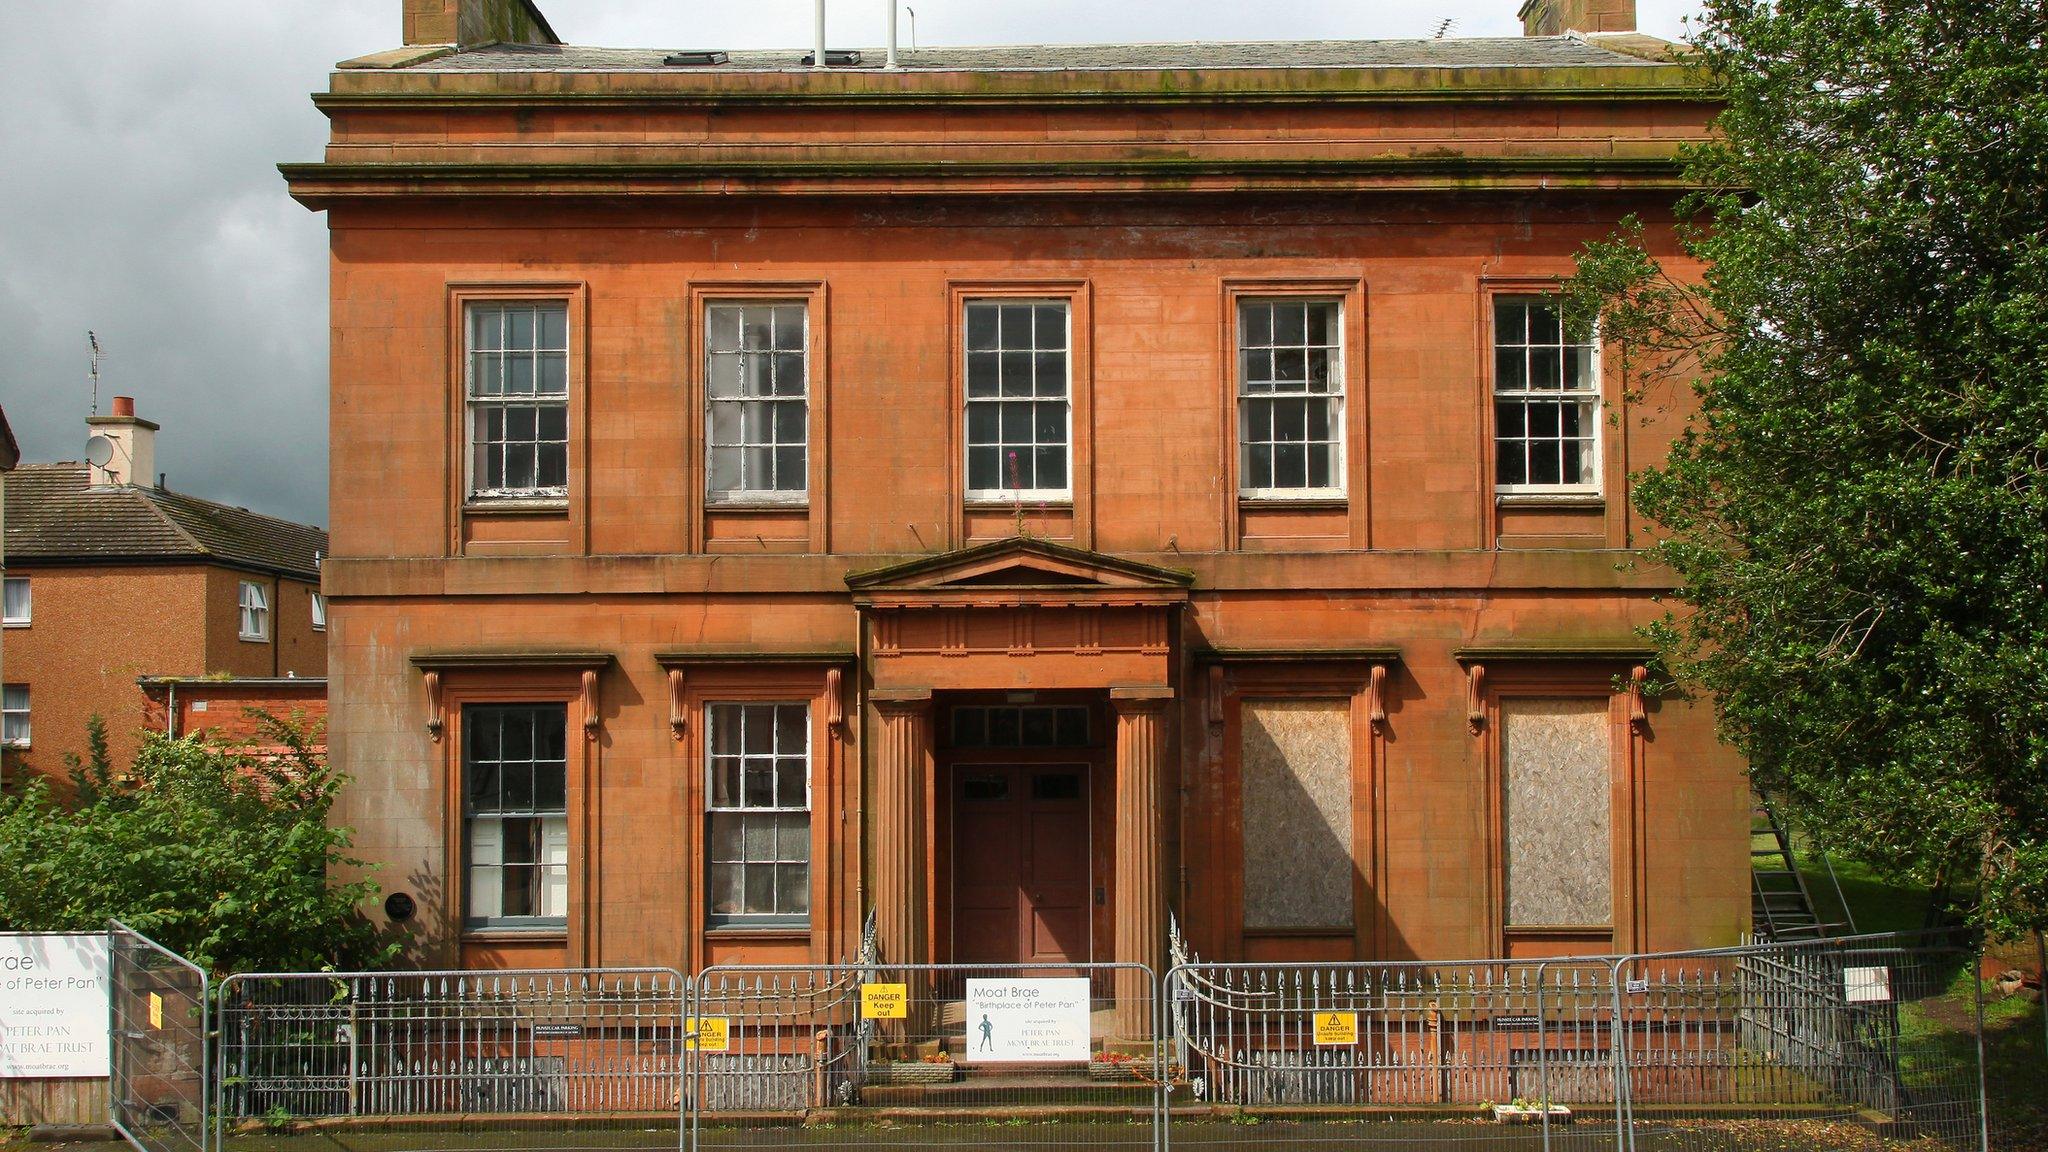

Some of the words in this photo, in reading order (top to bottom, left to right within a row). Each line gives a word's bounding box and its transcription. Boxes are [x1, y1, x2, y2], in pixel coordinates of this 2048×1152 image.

[6, 977, 21, 990] of
[25, 977, 63, 989] Peter
[867, 993, 901, 1001] DANGER
[973, 987, 1007, 998] Moat
[1011, 987, 1039, 998] Brae
[873, 1001, 895, 1009] Keep
[1023, 1001, 1032, 1009] of
[1034, 1001, 1056, 1009] Peter
[25, 1007, 55, 1016] acquired
[56, 1006, 65, 1016] by
[6, 1026, 42, 1037] PETER
[46, 1025, 71, 1036] PAN
[1021, 1029, 1043, 1037] PETER
[1045, 1029, 1061, 1037] PAN
[20, 1043, 54, 1054] BRAE
[57, 1042, 94, 1053] TRUST
